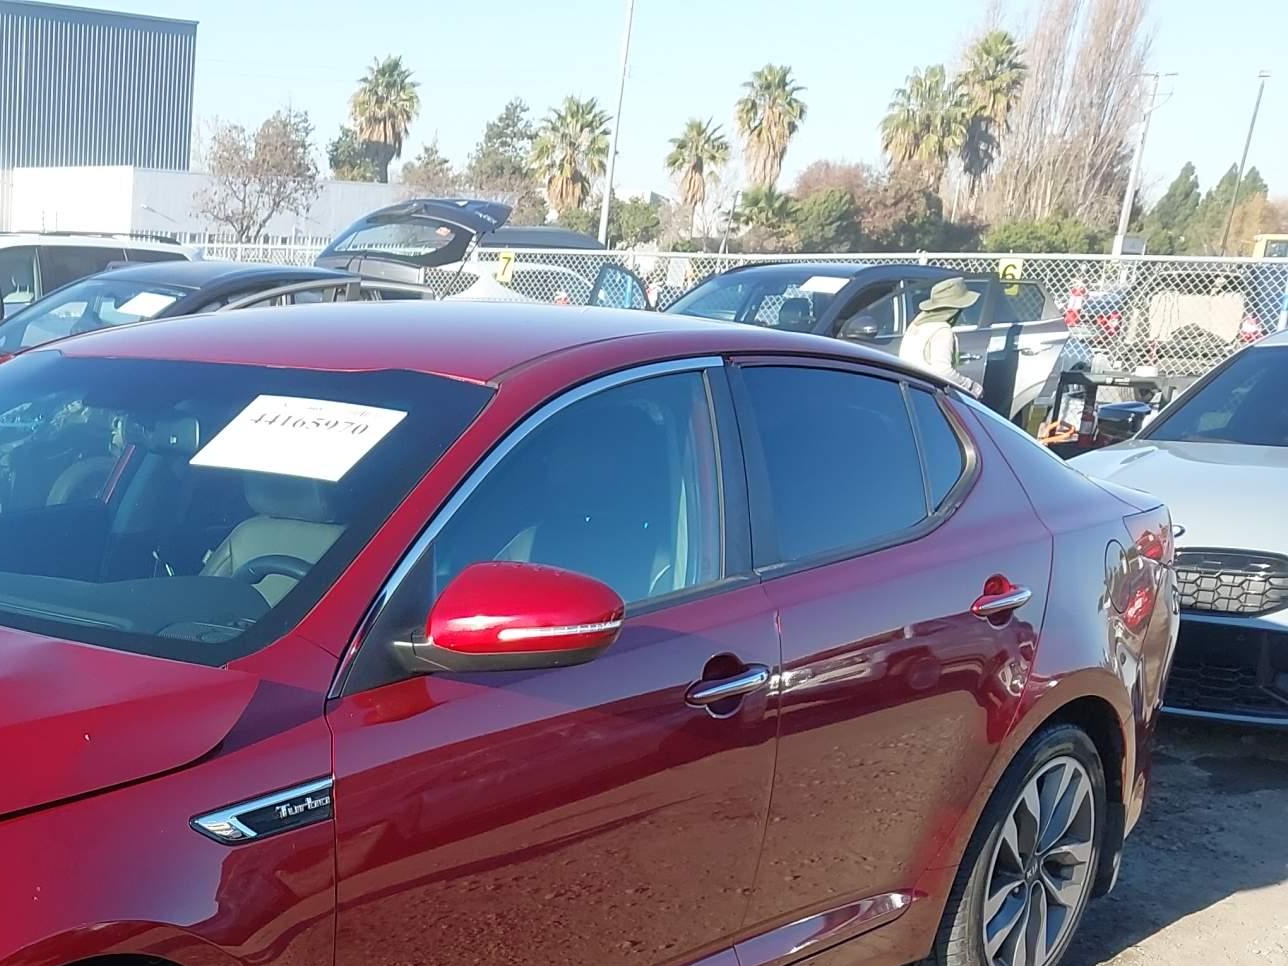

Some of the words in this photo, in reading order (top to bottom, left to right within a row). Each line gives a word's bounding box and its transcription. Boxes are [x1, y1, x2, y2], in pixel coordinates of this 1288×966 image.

[502, 256, 512, 276] 7
[1002, 263, 1017, 289] 6
[249, 412, 369, 436] 44165970
[275, 795, 330, 819] Turbo
